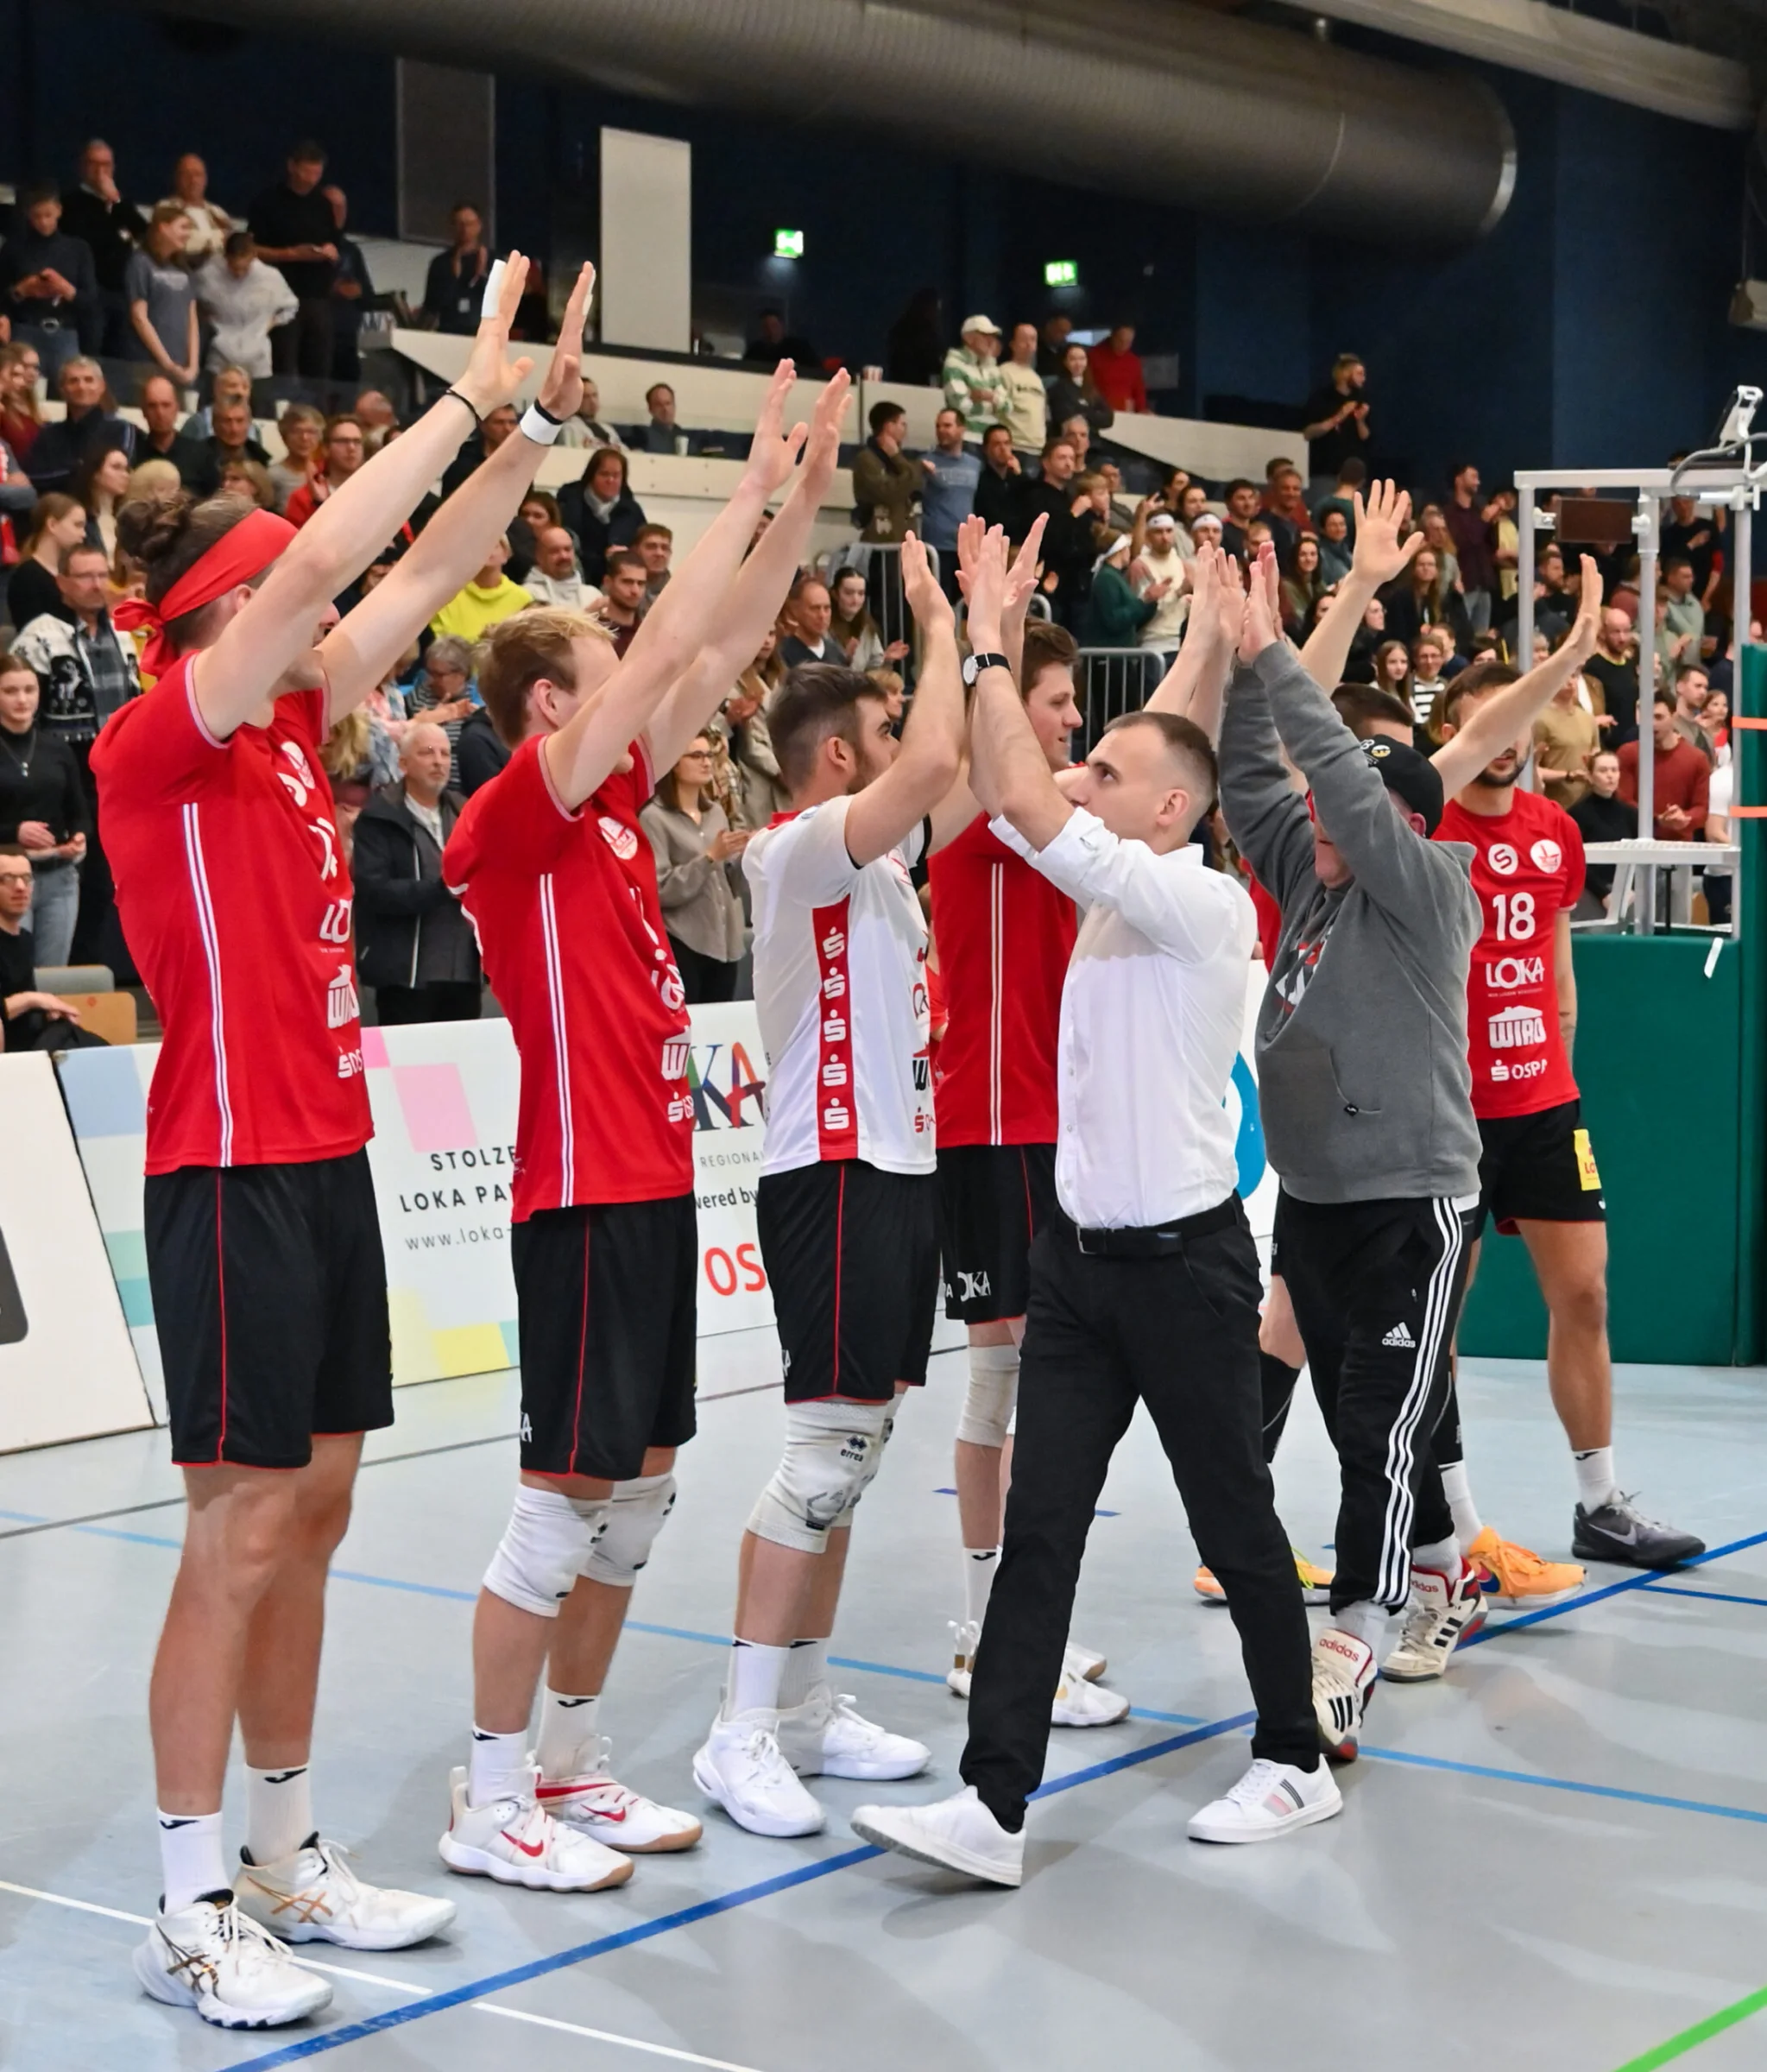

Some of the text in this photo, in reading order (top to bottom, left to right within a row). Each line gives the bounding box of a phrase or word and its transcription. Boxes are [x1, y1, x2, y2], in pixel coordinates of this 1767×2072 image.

[1492, 892, 1536, 942] 18
[1486, 957, 1545, 989] LOKA
[400, 1188, 466, 1212] LOKA
[1382, 1337, 1416, 1349] adidas
[1319, 1639, 1360, 1662] adidas
